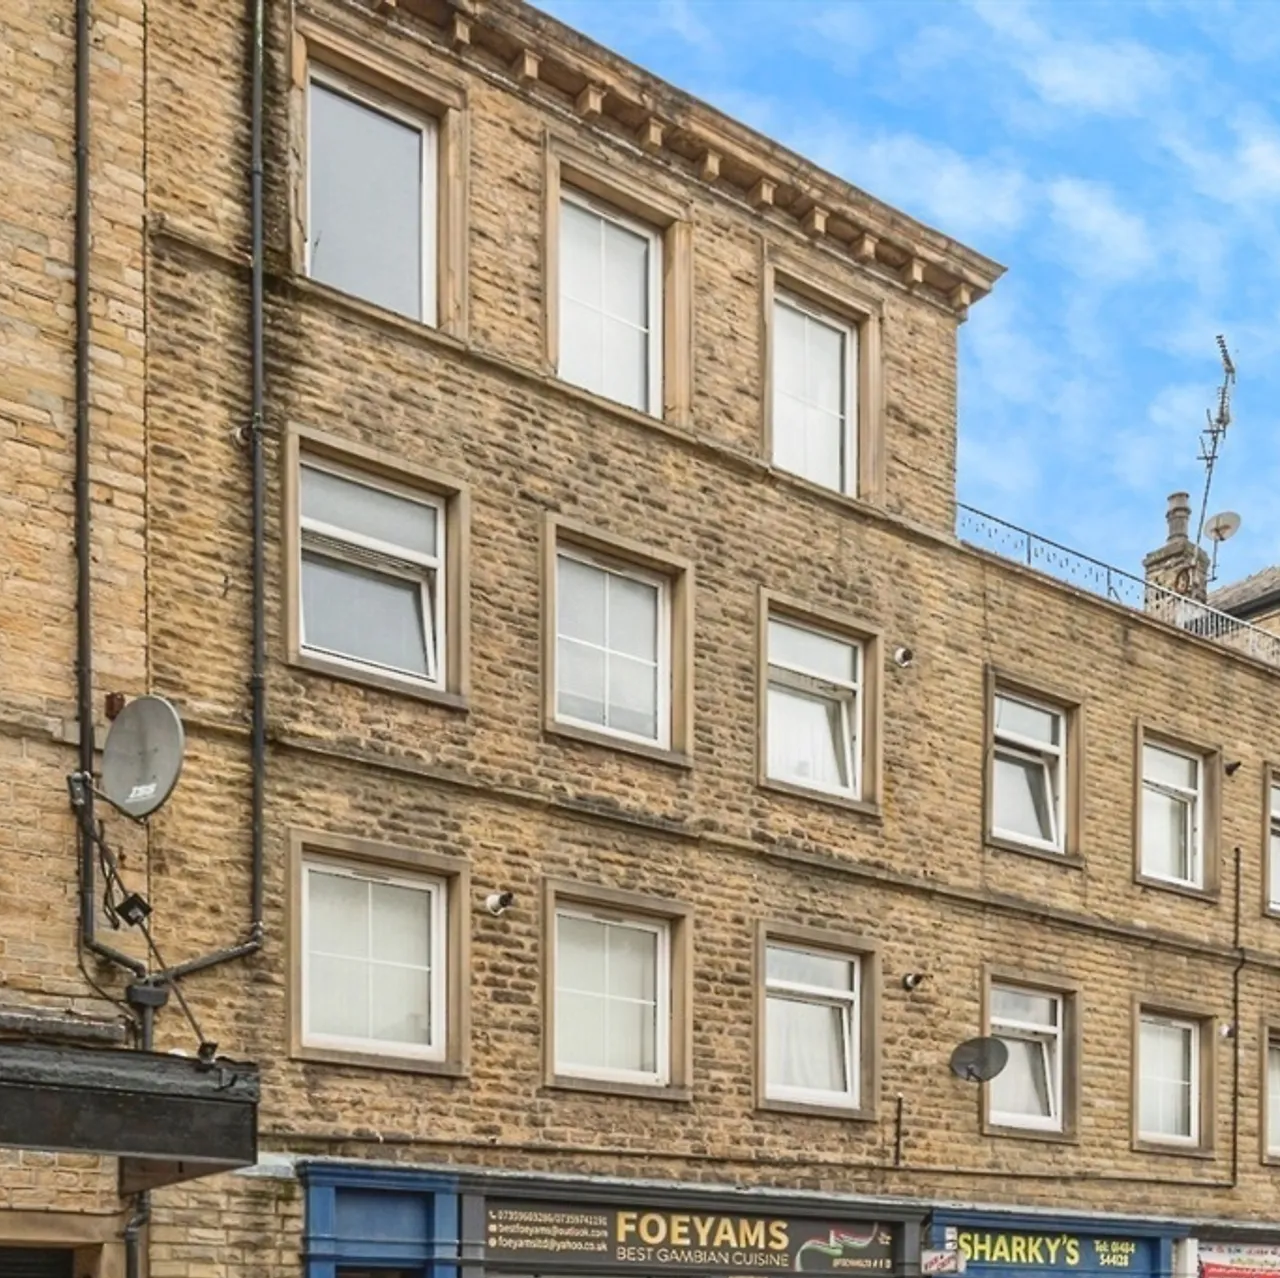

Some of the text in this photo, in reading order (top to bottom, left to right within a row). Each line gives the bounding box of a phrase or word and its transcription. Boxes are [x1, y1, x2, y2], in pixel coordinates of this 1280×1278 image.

[616, 1211, 790, 1250] FOEYAMS
[616, 1247, 789, 1267] BEST GAMBIAN CUISINE
[958, 1231, 1080, 1266] SHARKY'S
